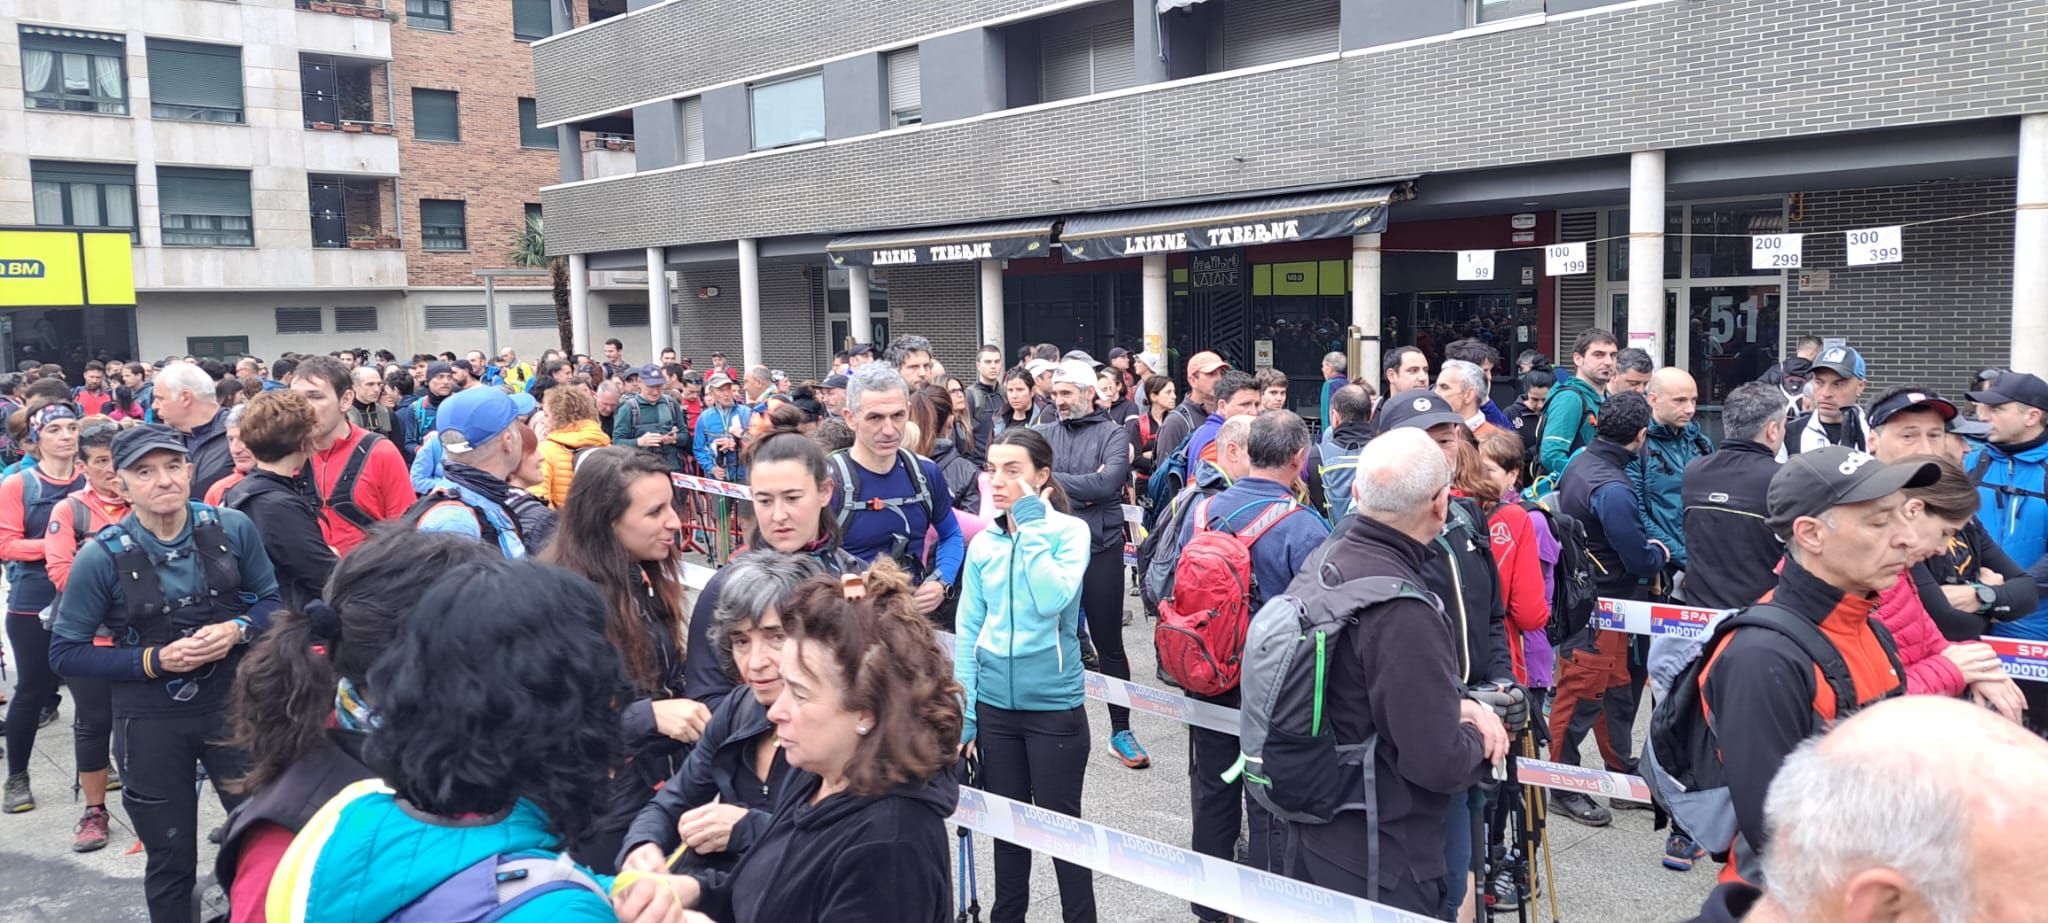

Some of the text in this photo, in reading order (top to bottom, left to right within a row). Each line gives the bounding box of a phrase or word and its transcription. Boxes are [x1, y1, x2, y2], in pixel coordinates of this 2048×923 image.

[1207, 220, 1299, 247] TABERNA
[1850, 231, 1879, 245] 300
[1755, 237, 1781, 250] 200
[930, 242, 993, 261] TABERNA
[1467, 253, 1472, 263] 1
[1549, 247, 1570, 258] 100
[1869, 247, 1898, 262] 399
[1563, 261, 1585, 272] 199
[1772, 254, 1799, 266] 299
[8, 262, 39, 275] BM
[1475, 268, 1488, 278] 99
[1710, 295, 1758, 344] 51
